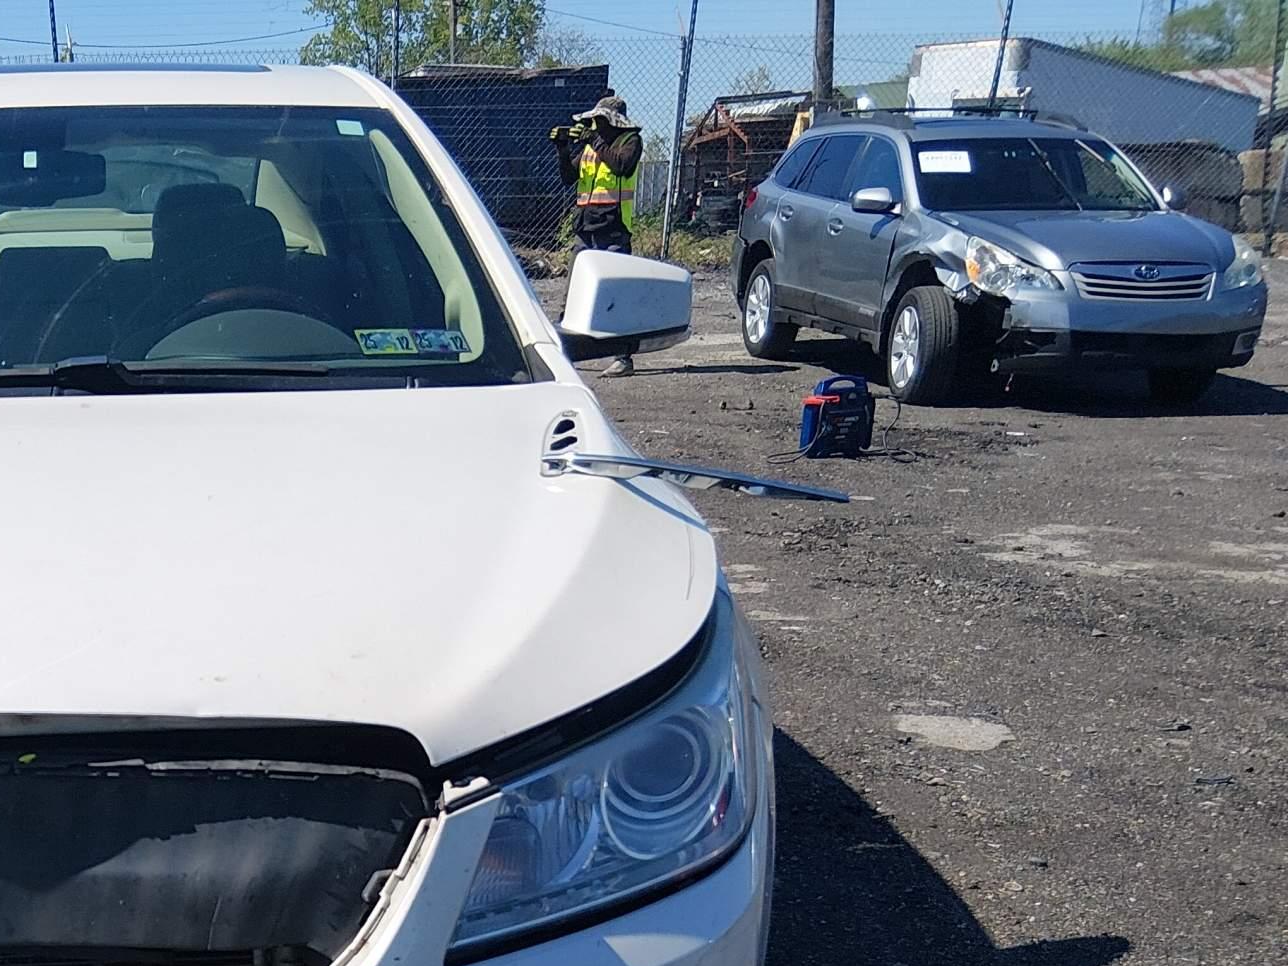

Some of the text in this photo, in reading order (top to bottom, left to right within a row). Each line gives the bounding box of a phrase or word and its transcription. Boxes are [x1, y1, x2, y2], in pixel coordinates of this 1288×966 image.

[360, 333, 413, 350] 25 12
[415, 332, 467, 351] 25 12
